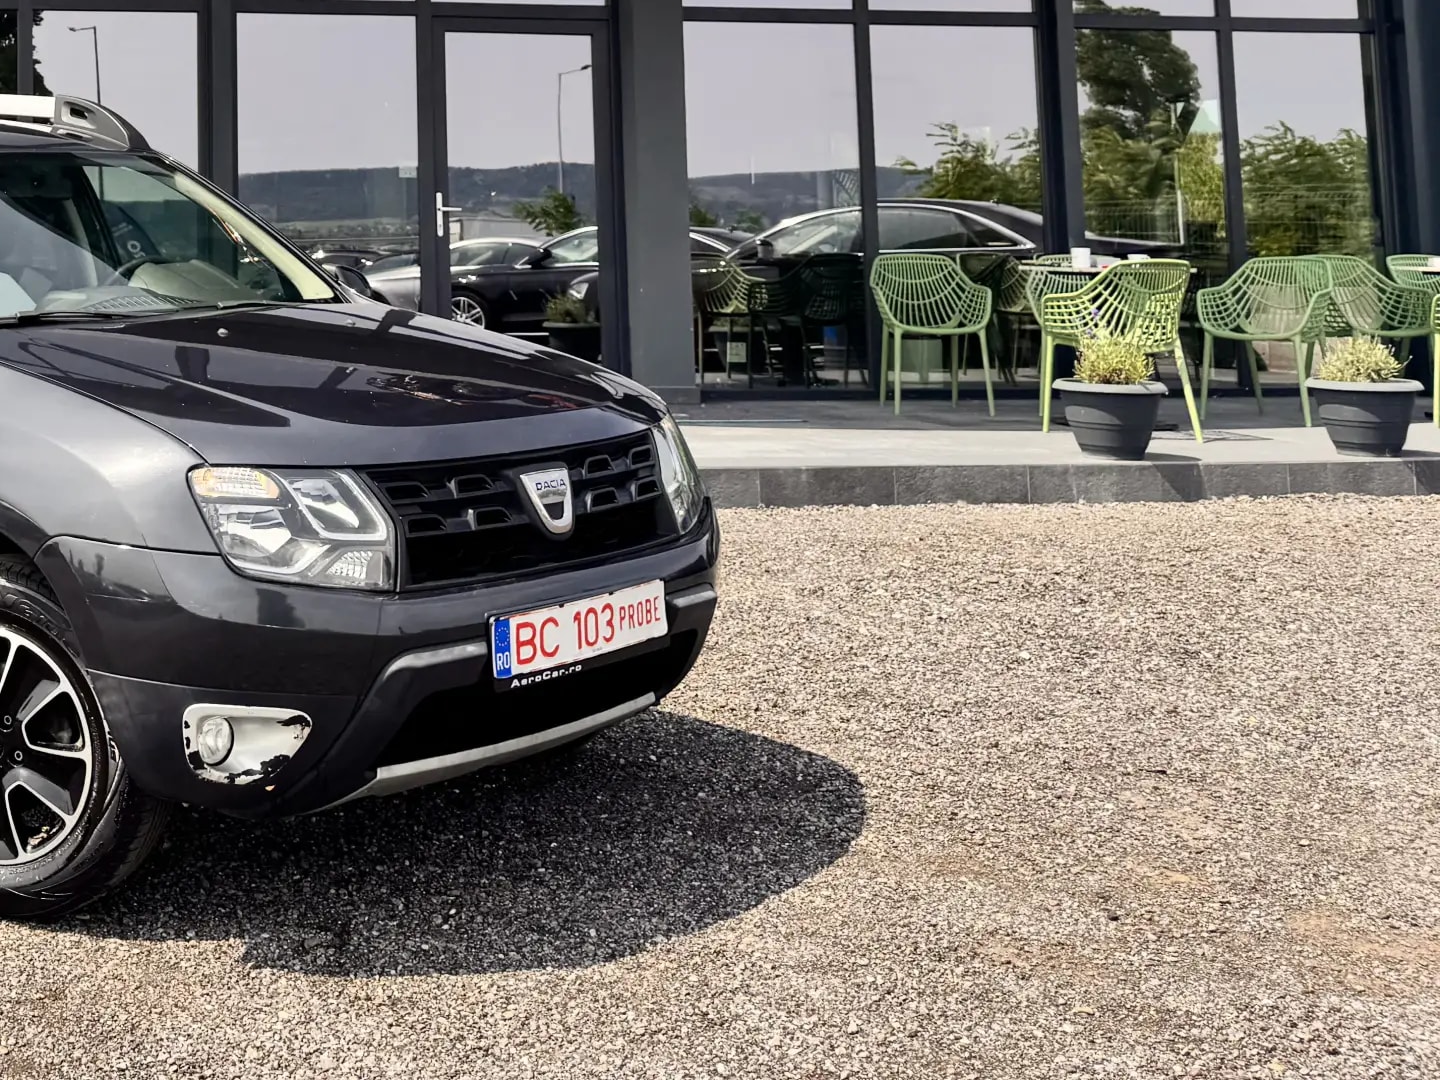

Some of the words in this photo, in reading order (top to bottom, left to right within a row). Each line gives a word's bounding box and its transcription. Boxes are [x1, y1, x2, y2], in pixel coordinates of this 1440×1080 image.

[535, 478, 566, 491] DACIA
[515, 616, 560, 665] BC
[572, 602, 616, 650] 103
[618, 595, 661, 632] PROBE
[496, 651, 511, 671] RO
[510, 664, 582, 688] AeroCar.ro
